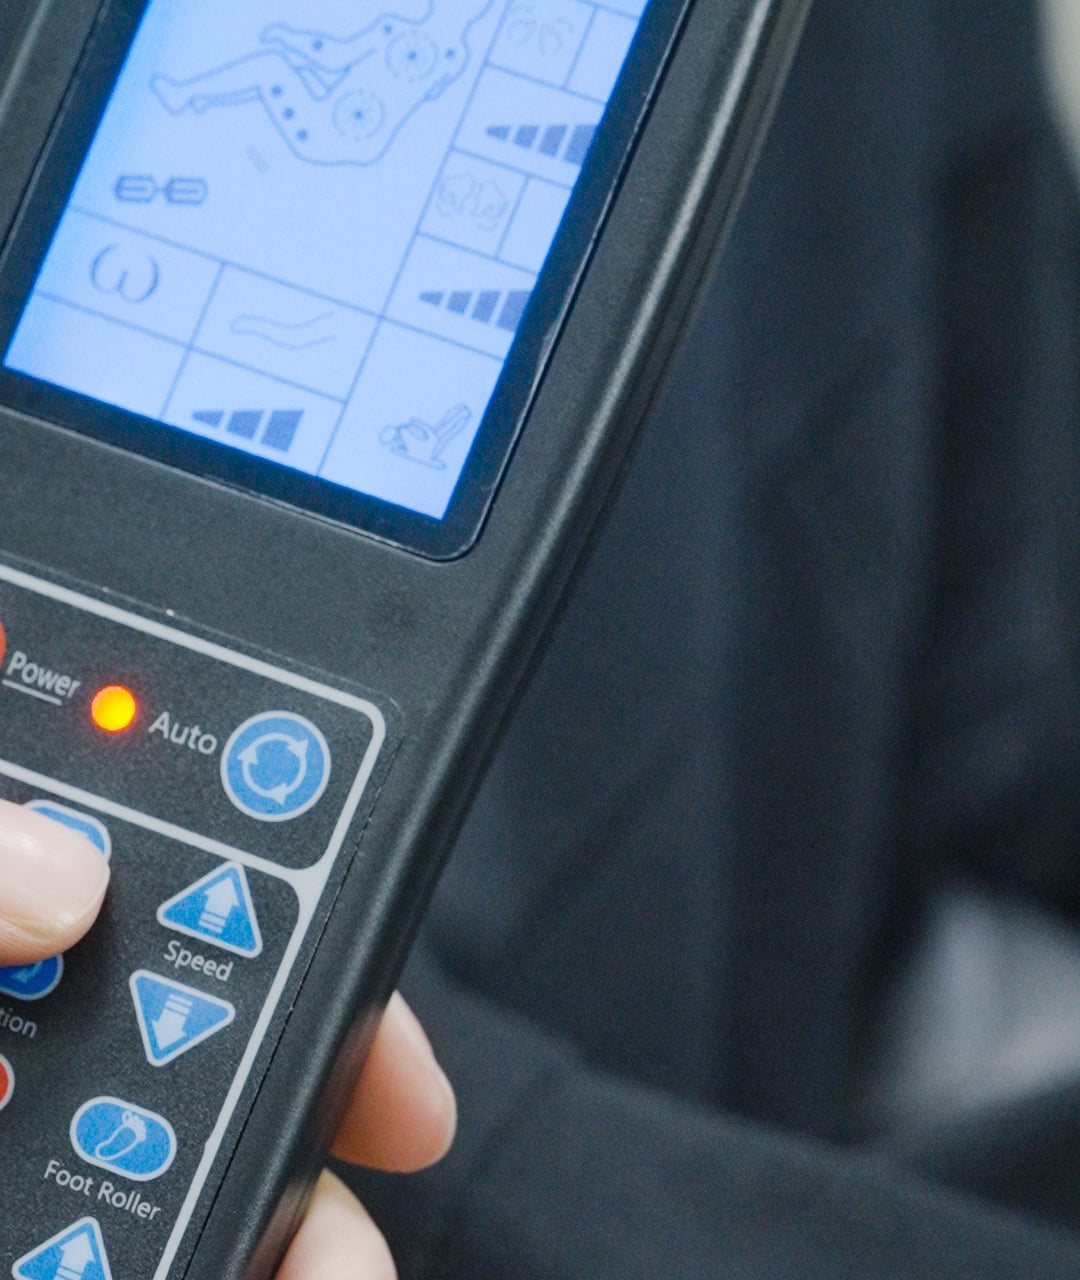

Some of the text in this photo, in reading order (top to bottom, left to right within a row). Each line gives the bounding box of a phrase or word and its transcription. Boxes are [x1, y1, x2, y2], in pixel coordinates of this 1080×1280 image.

[6, 650, 80, 699] Power
[148, 710, 218, 756] Auto
[163, 939, 233, 982] Speed
[43, 1159, 162, 1222] Foot Roller
